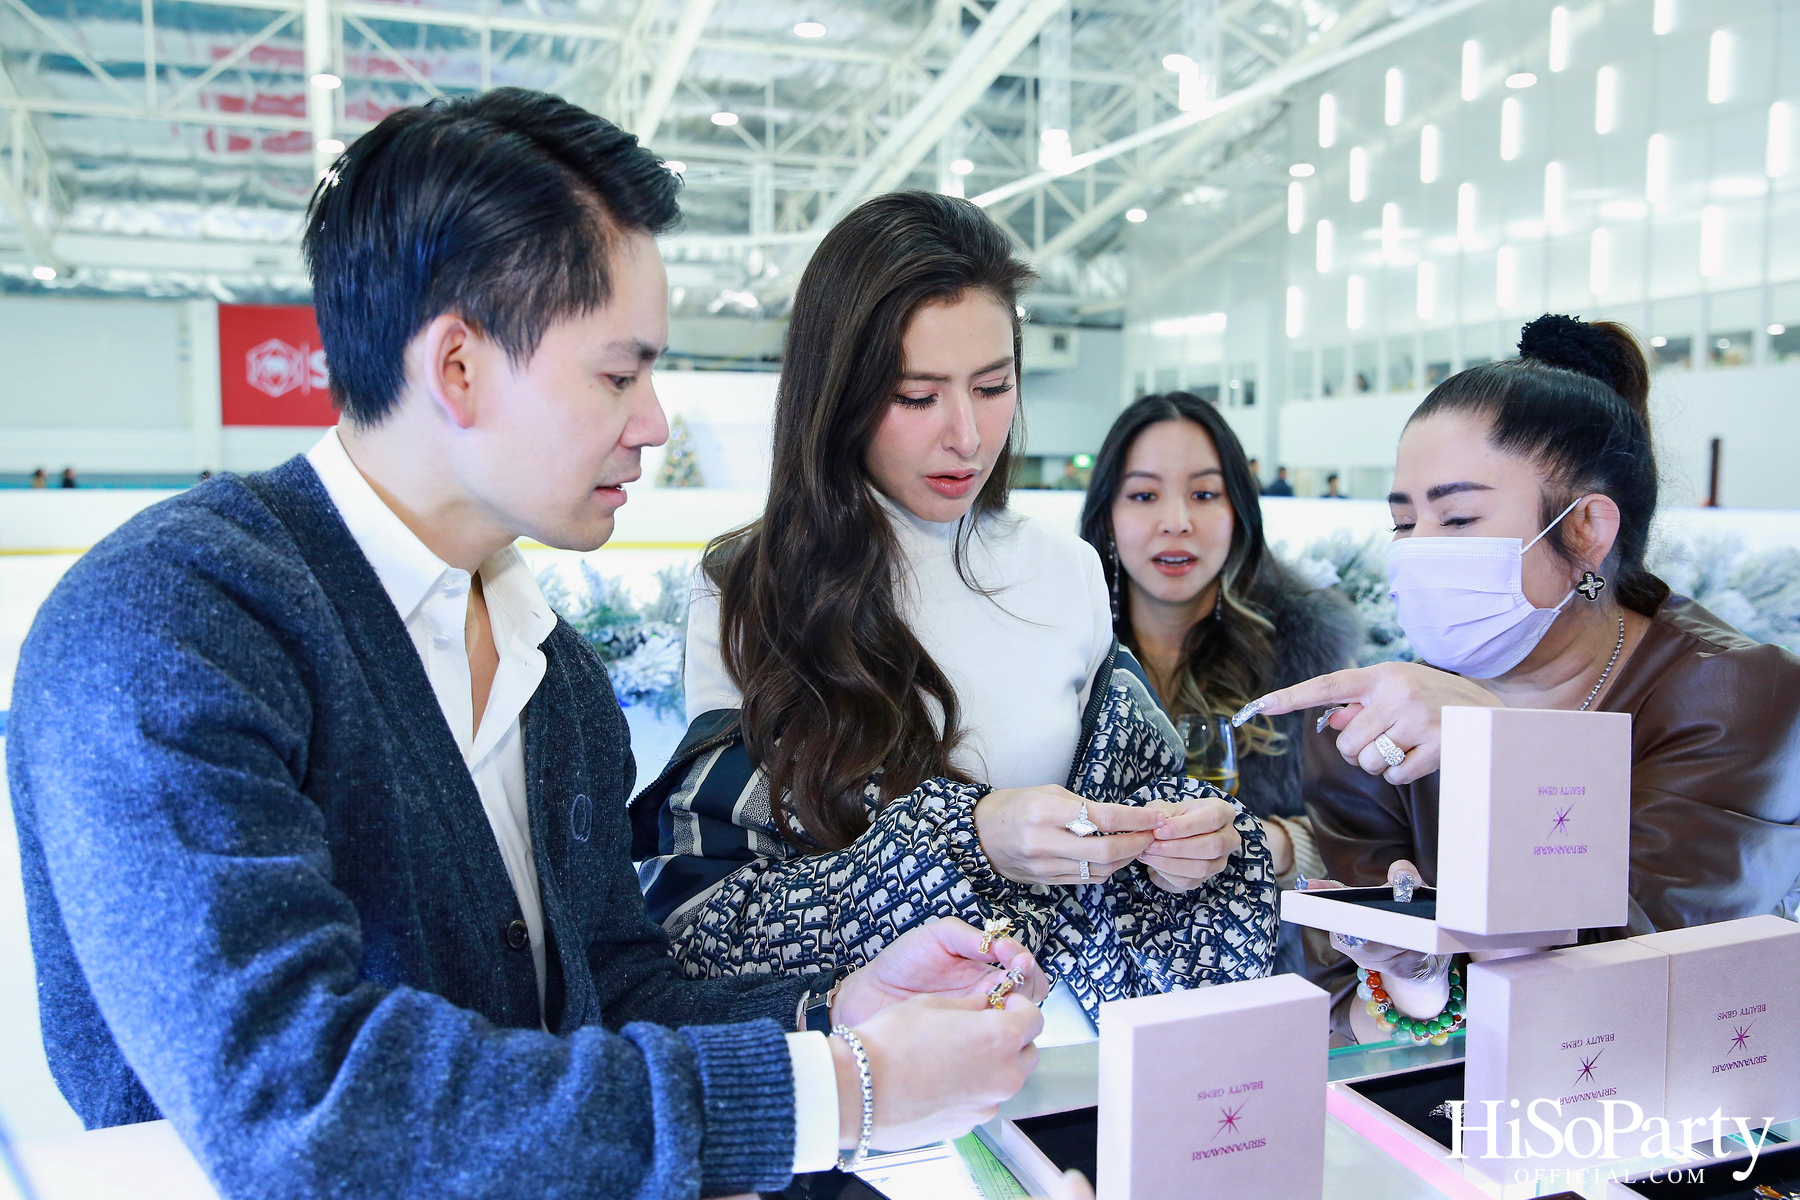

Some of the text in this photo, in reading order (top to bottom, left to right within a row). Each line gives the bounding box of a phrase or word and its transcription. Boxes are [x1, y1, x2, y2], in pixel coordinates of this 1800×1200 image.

[1537, 786, 1586, 796] BEAUTY GEMS
[1533, 844, 1588, 856] SIRIVANNAVARI
[1717, 1003, 1767, 1021] BEAUTY GEMS
[1561, 1033, 1615, 1051] BEAUTY GEMS
[1712, 1054, 1768, 1074] SIRIVANNAVARI
[1197, 1080, 1264, 1101] BEAUTY GEMS
[1558, 1086, 1617, 1106] SIRIVANNAVAR
[1191, 1138, 1267, 1161] SIRIVANNAVARI
